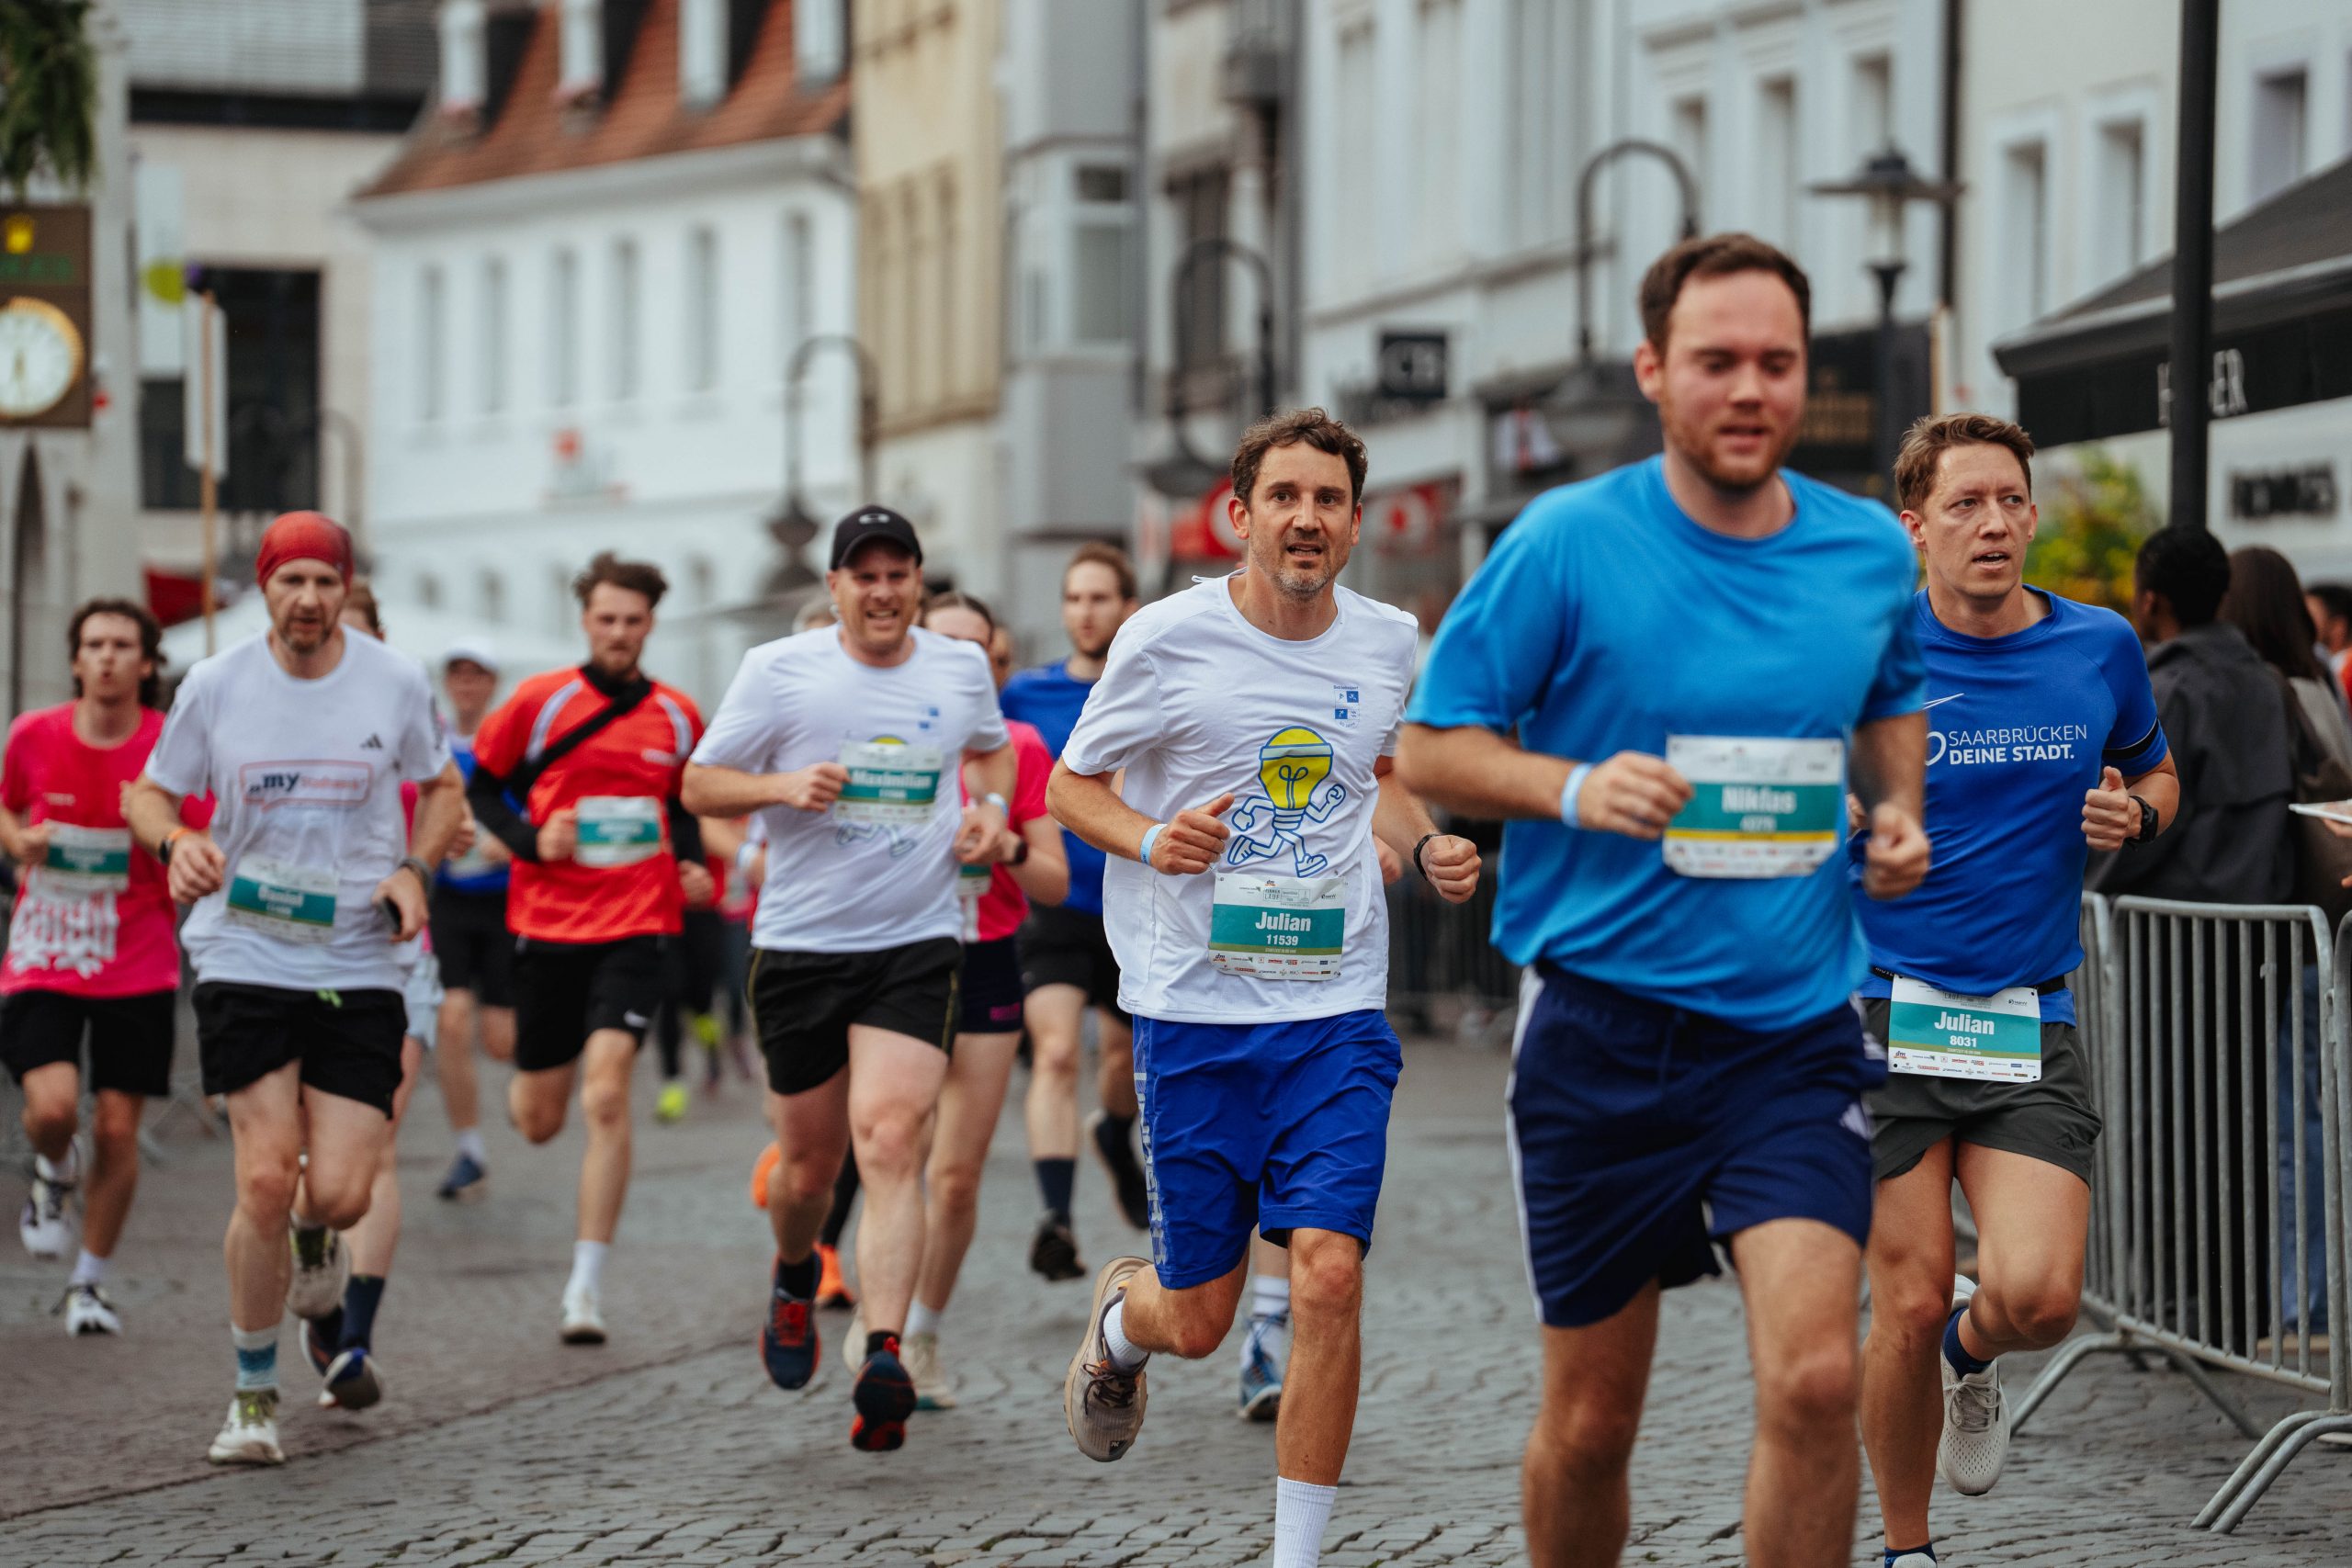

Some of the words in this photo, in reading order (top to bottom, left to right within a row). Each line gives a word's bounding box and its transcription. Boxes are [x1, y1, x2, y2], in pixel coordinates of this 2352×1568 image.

[1948, 725, 2087, 747] SAARBRÜCKEN
[1949, 747, 2007, 765] DEINE
[2012, 744, 2075, 762] STADT.
[1255, 911, 1311, 931] Julian
[1266, 934, 1299, 946] 11539
[1934, 1011, 1995, 1035] Julian
[1950, 1035, 1977, 1048] 8031
